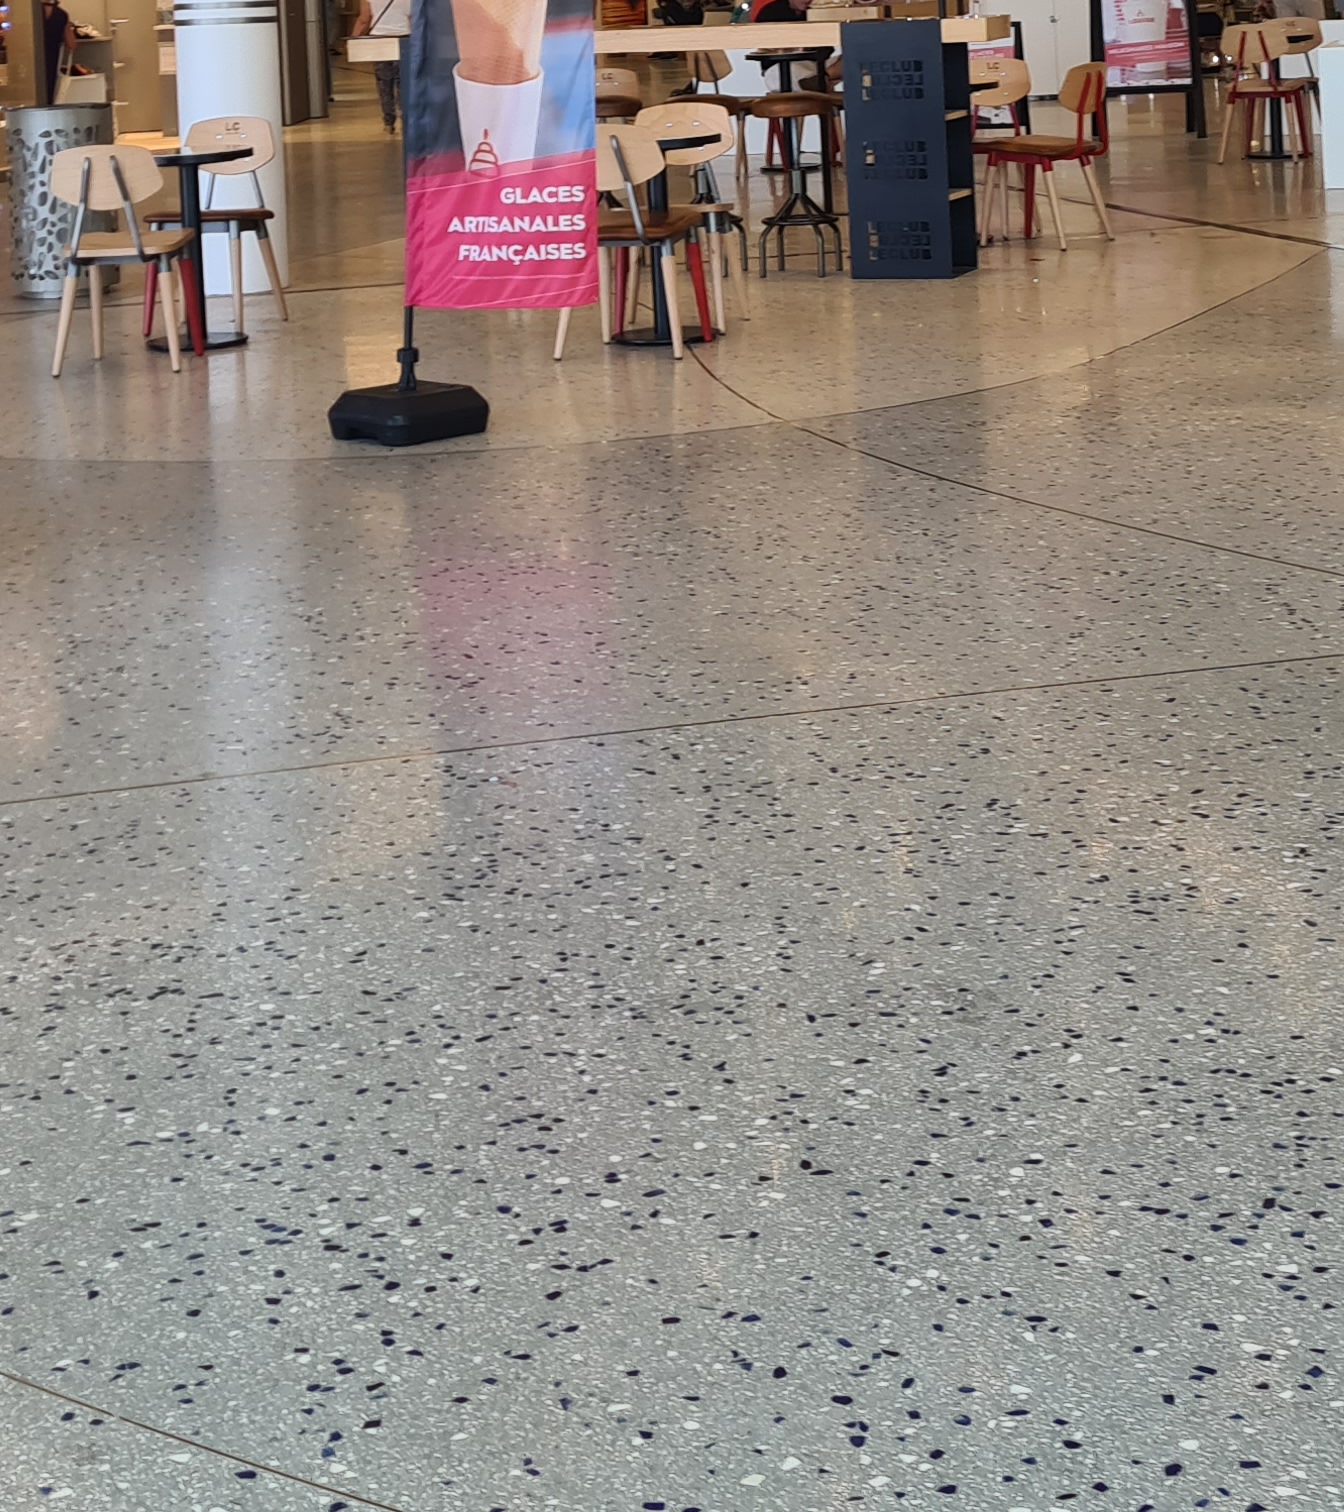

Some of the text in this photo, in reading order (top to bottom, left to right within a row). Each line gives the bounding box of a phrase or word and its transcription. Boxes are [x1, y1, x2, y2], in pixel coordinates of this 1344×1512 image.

[225, 122, 240, 131] LC
[500, 186, 585, 204] GLACES
[448, 215, 586, 232] ARTISANALES
[458, 243, 587, 265] FRANÇAISES
